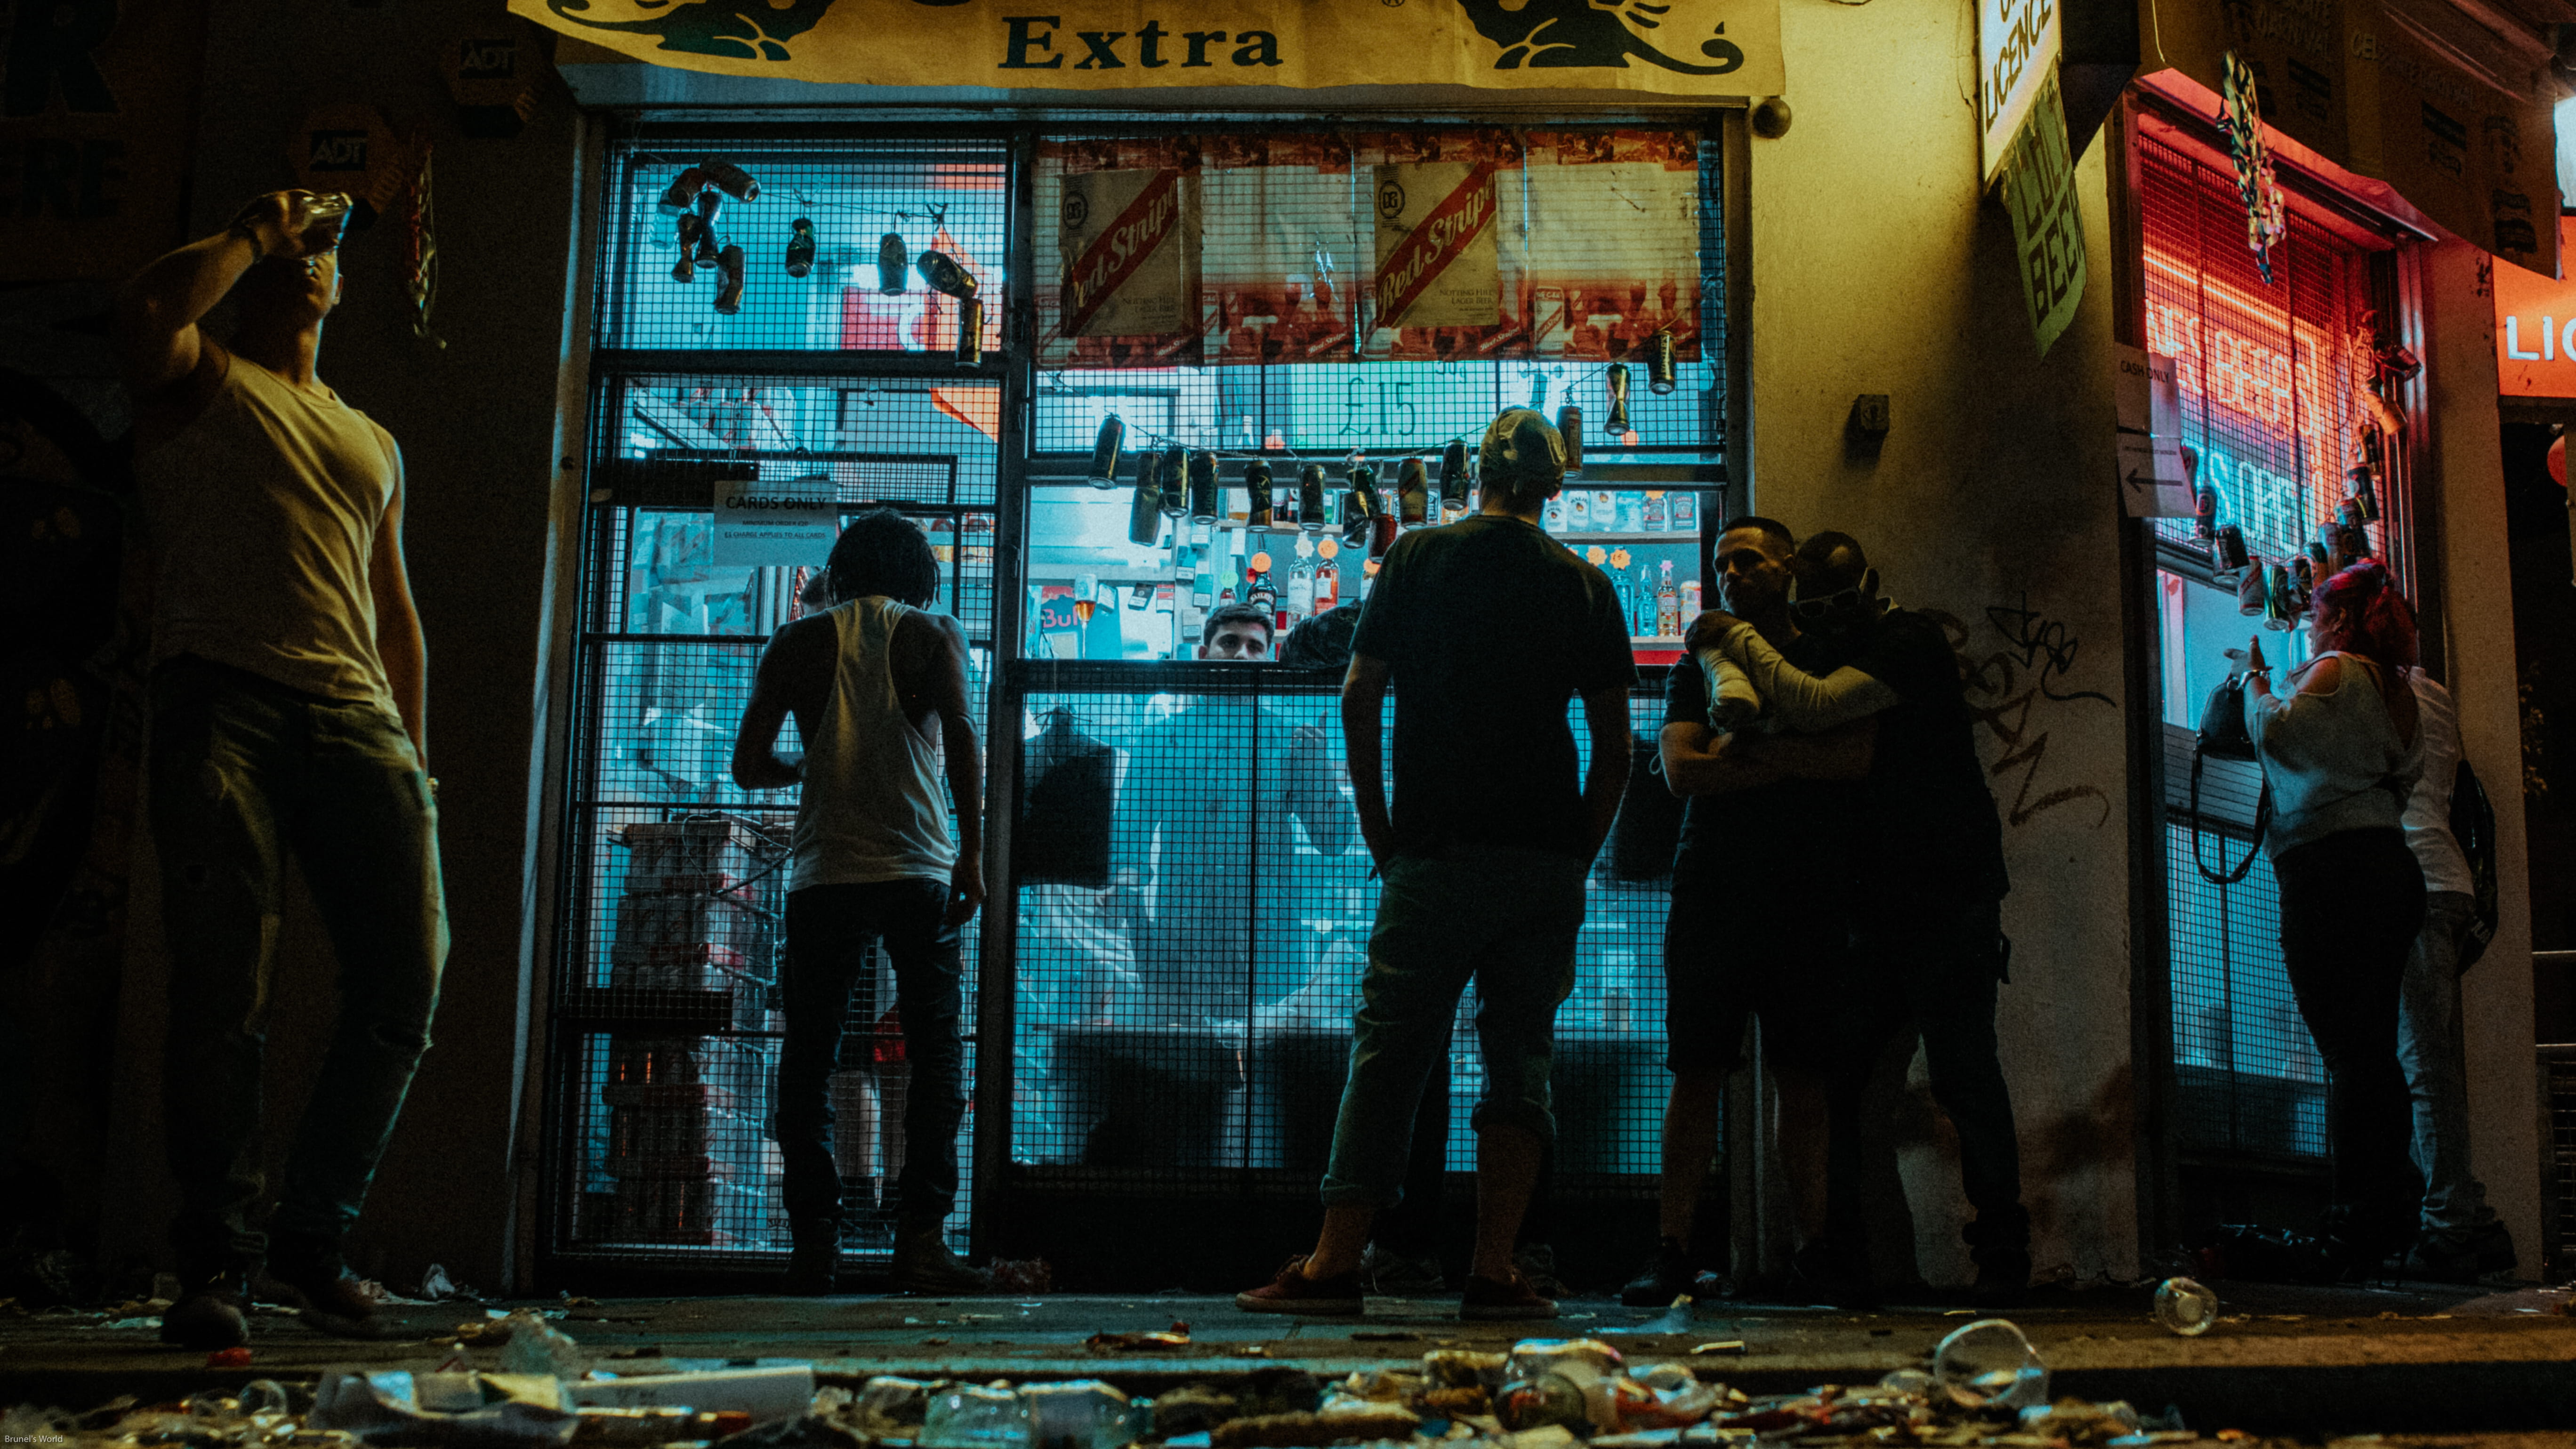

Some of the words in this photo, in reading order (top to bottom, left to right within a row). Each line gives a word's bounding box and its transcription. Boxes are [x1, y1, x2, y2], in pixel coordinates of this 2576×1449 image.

[459, 46, 518, 72] ADT
[998, 16, 1284, 69] Extra
[1985, 3, 2051, 135] LICENCE
[310, 137, 370, 167] ADT
[1108, 179, 1176, 274] Stripe
[2028, 165, 2084, 329] BEER
[1378, 244, 1425, 323] Red
[1425, 173, 1494, 265] Stripe
[1308, 340, 1325, 354] Red
[1326, 330, 1347, 345] Stripe
[1480, 339, 1497, 352] Red
[1497, 326, 1520, 343] Stripe
[2120, 360, 2145, 377] CASH
[2147, 366, 2170, 384] ONLY
[1339, 376, 1416, 436] £15
[725, 496, 779, 509] CARDS
[783, 497, 827, 510] ONLY
